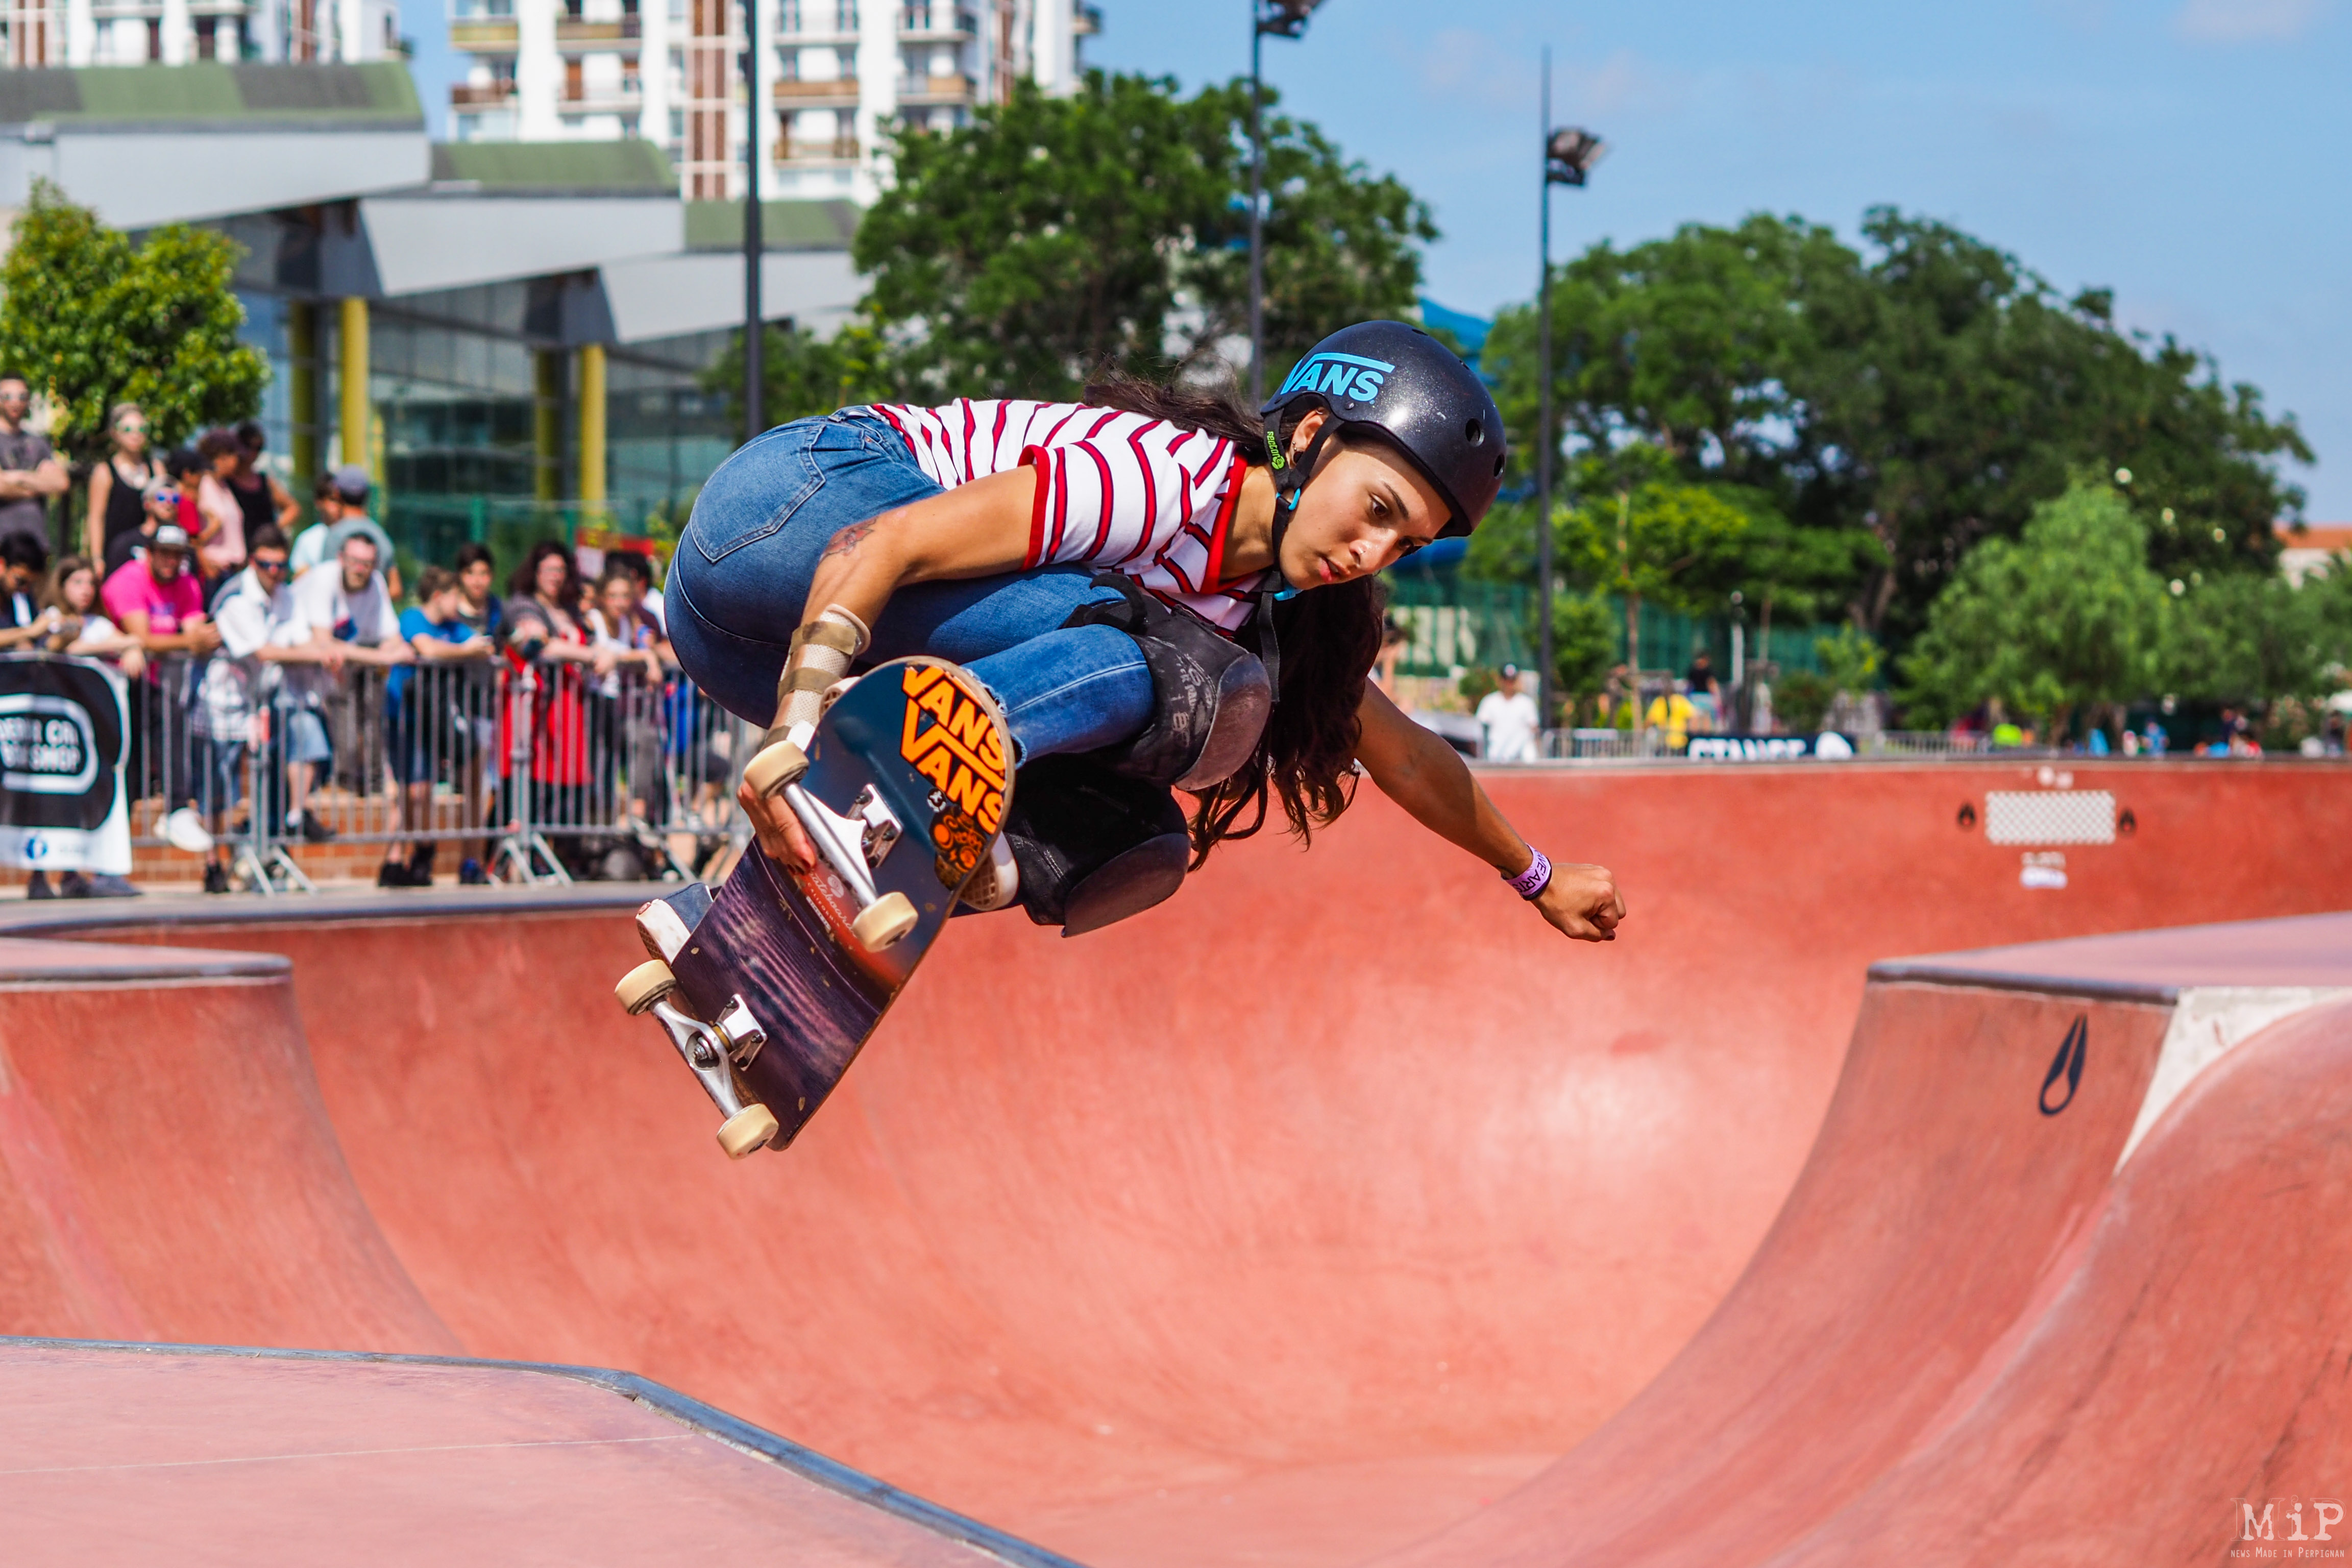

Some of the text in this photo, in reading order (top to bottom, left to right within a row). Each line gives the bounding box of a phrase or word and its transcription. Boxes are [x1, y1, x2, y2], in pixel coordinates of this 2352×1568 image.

[1280, 352, 1395, 402] VANS
[1267, 431, 1281, 457] sector
[902, 666, 1007, 773] VANS
[900, 698, 1007, 835] VANS
